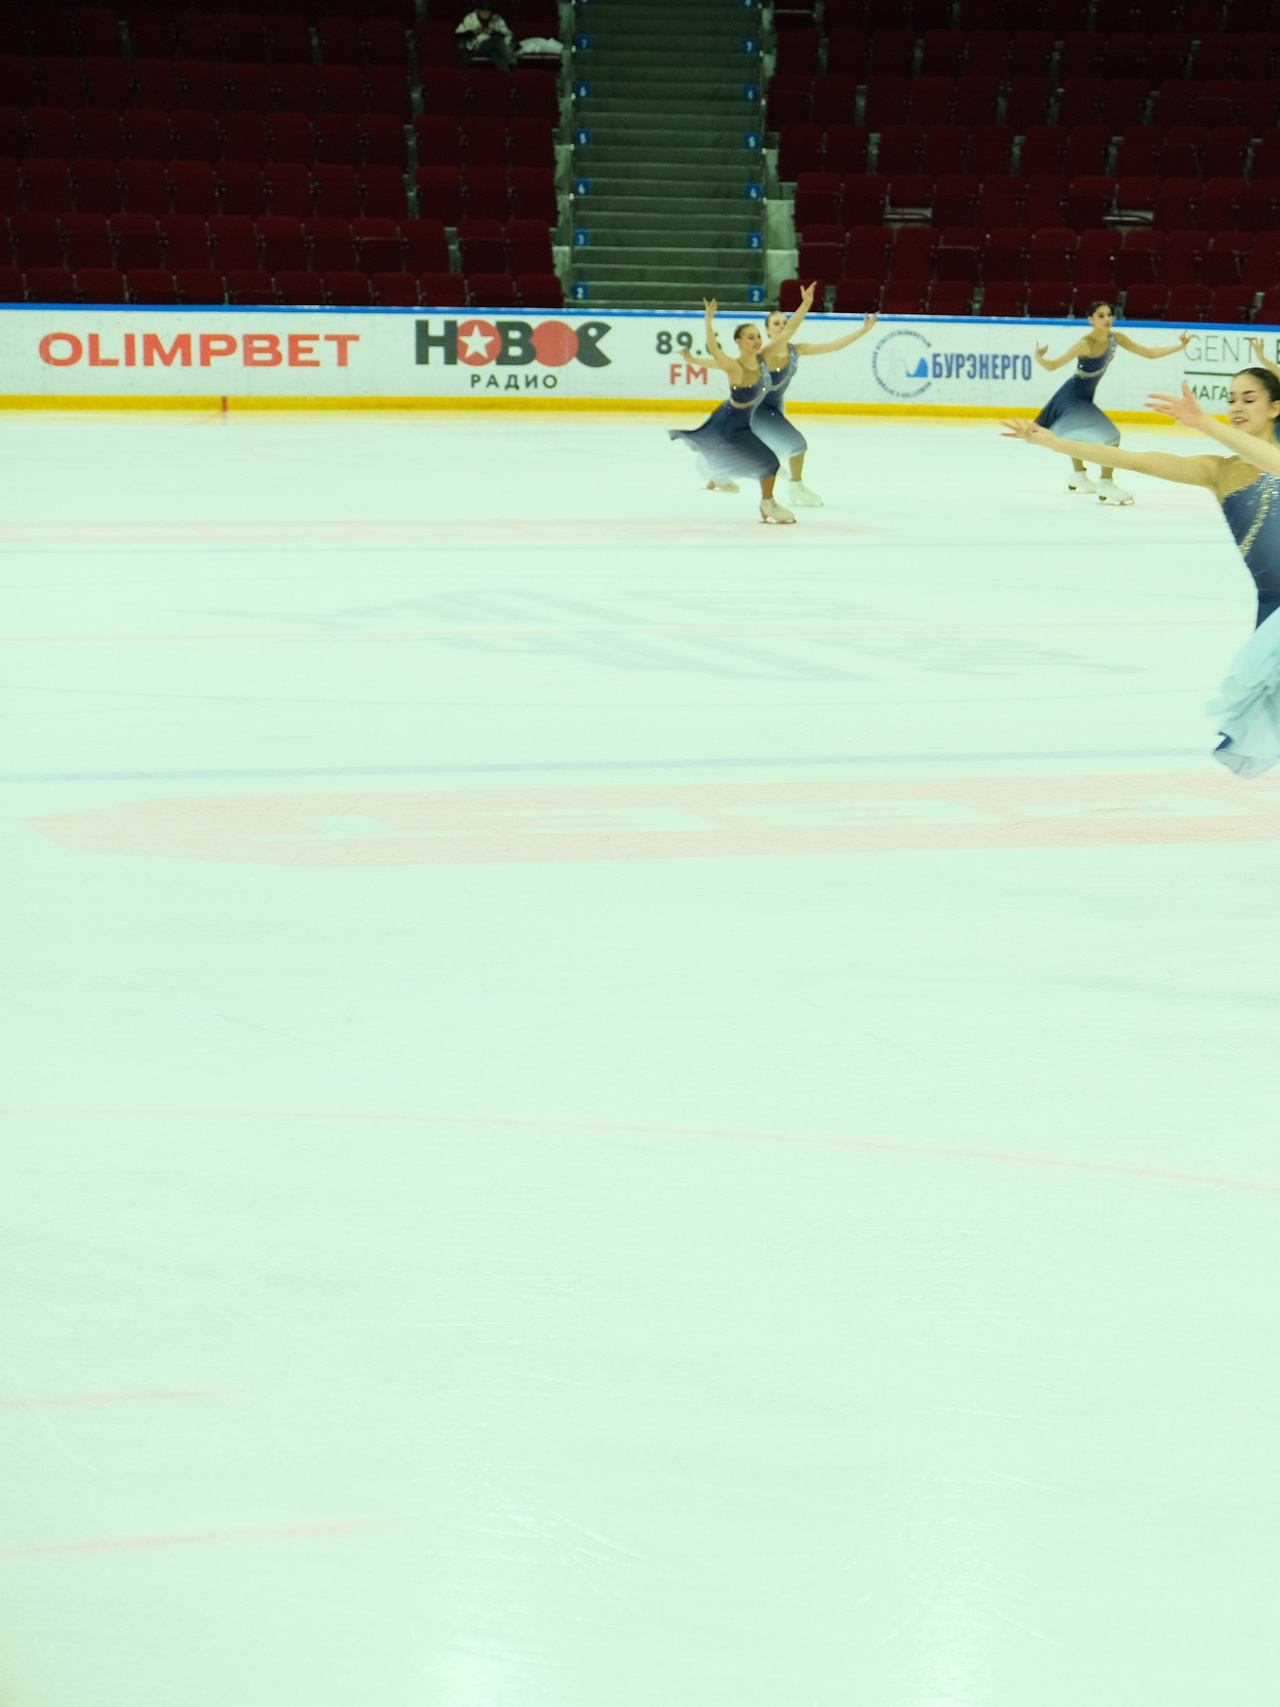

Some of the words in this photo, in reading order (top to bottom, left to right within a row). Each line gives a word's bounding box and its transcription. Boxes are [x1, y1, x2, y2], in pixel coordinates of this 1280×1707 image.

[38, 332, 360, 367] OLIMPBET
[670, 363, 708, 385] FM
[932, 353, 1032, 381] БУРЭНЕРГО
[470, 374, 558, 390] РАДИО
